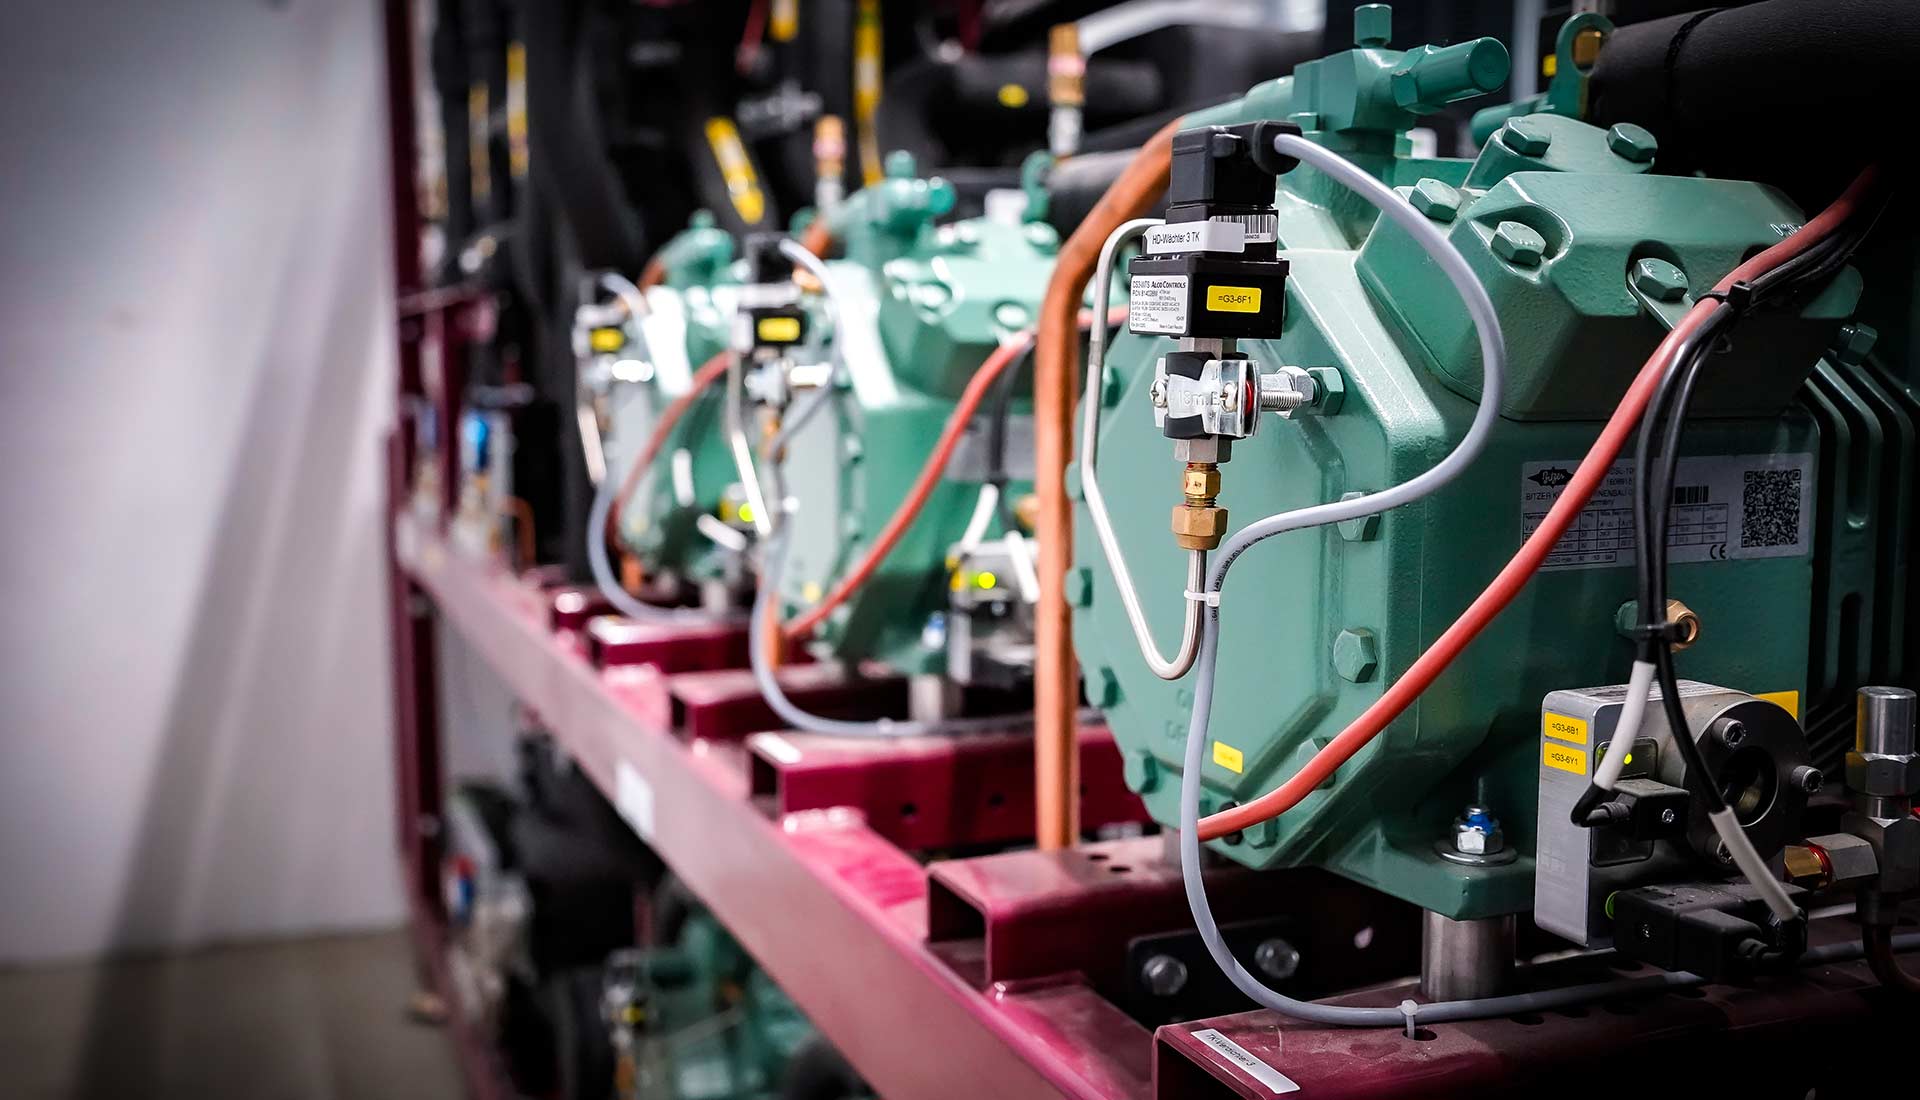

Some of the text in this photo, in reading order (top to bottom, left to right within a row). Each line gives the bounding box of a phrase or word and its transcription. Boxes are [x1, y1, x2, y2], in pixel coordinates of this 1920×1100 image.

[1152, 231, 1200, 245] HD-Wächter 3 TK
[1218, 294, 1251, 304] =G3-6F1
[1526, 491, 1551, 501] BITZER
[1709, 544, 1727, 560] CE
[1552, 723, 1579, 736] =G3-6B1
[1551, 753, 1578, 766] =G3-6Y1
